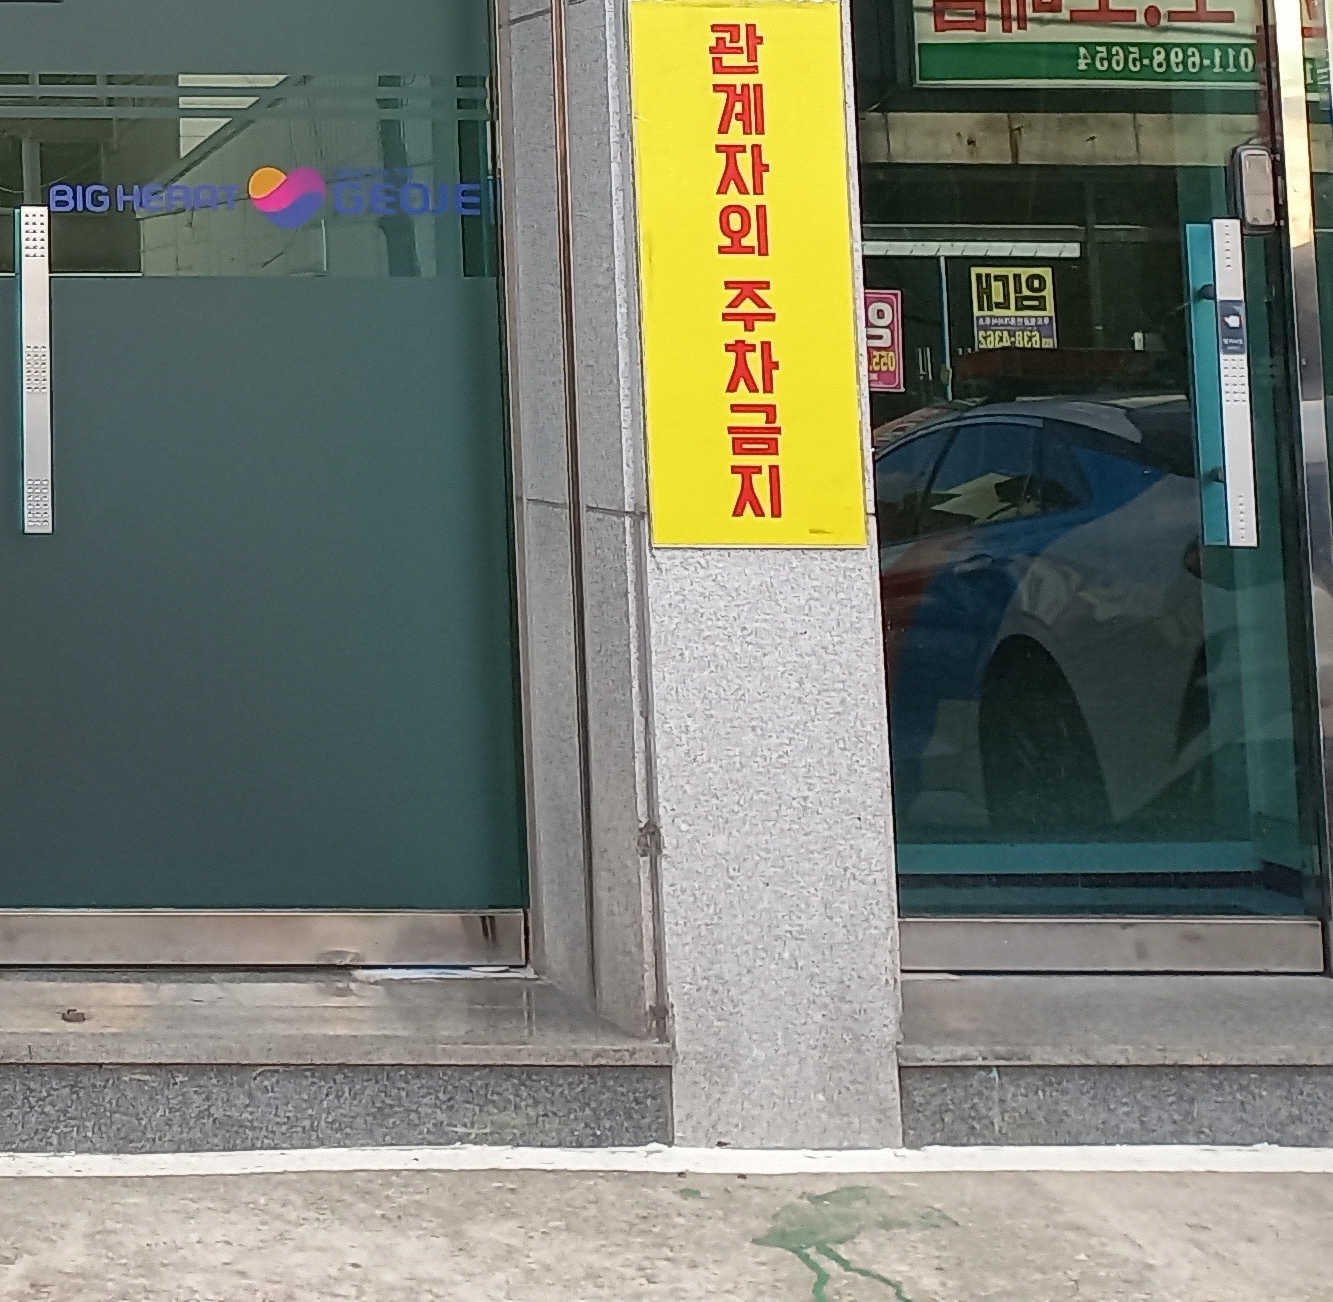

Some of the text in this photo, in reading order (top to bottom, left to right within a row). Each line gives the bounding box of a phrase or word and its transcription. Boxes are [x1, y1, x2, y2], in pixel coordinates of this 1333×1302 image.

[49, 182, 483, 216] BIG HEART GEOJE
[709, 23, 782, 518] 관계자외 주차금지
